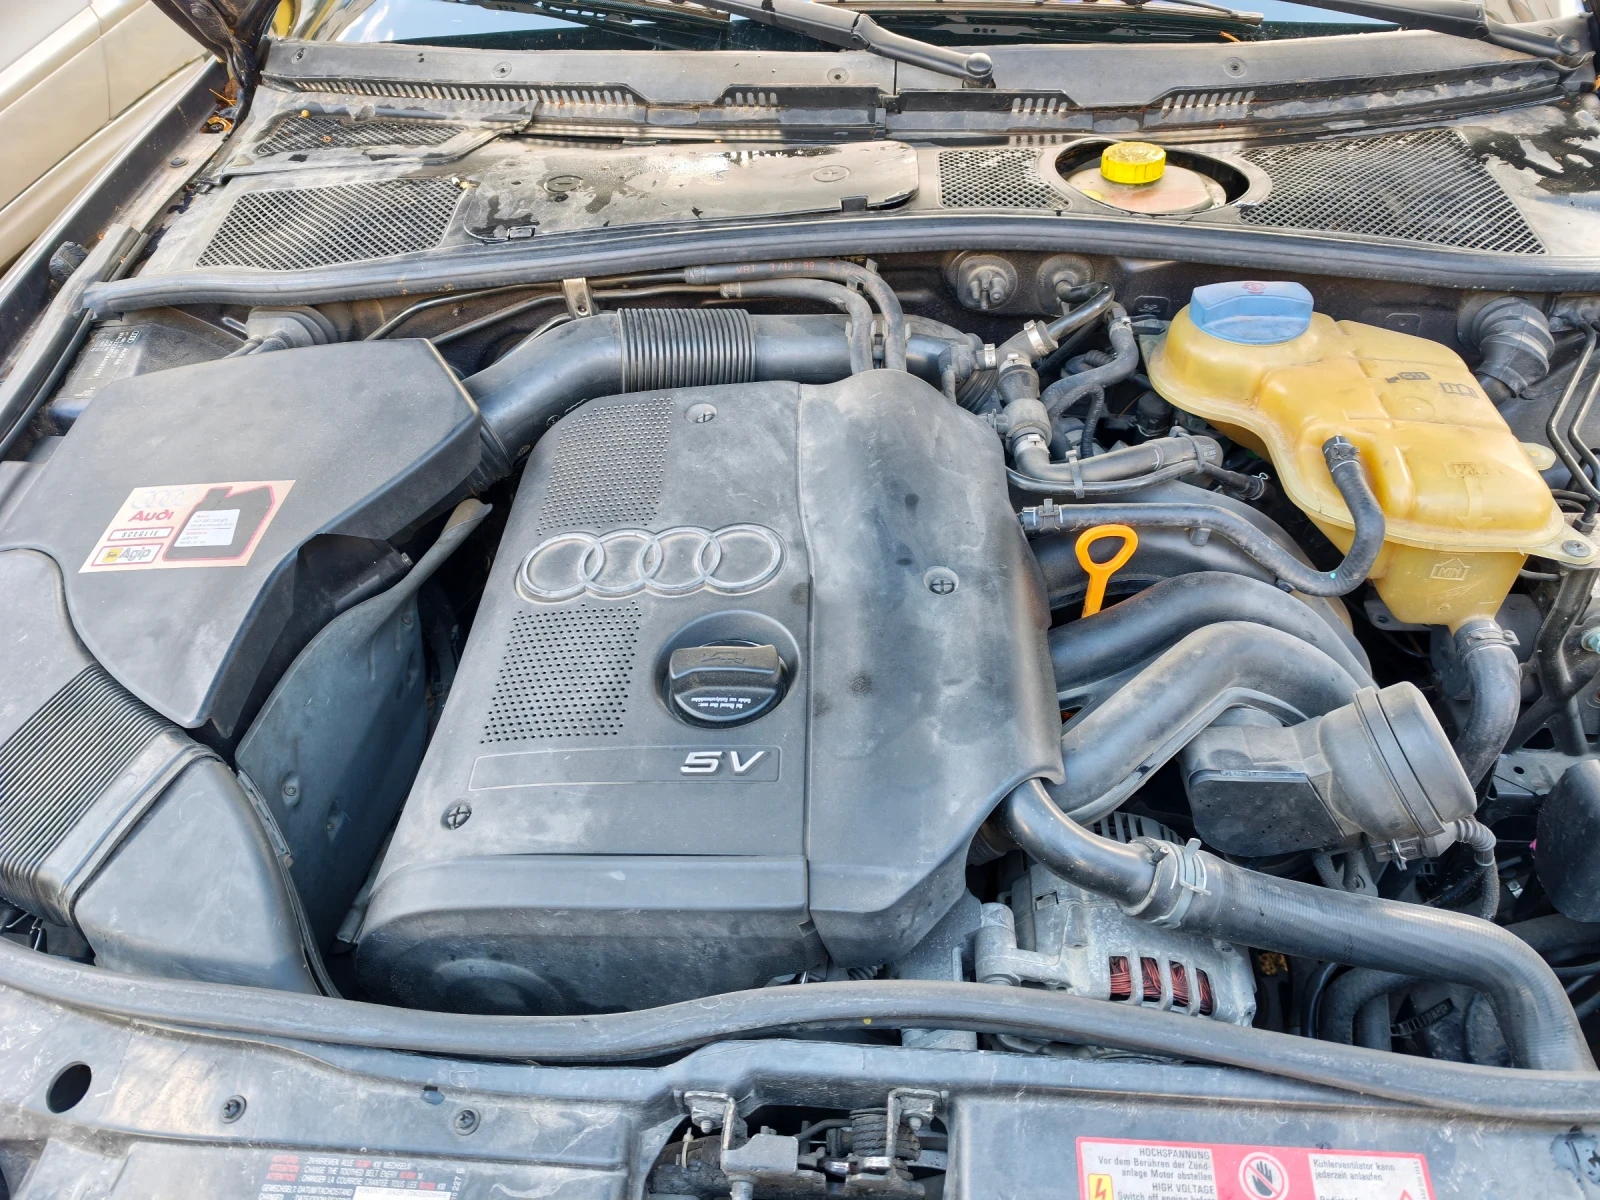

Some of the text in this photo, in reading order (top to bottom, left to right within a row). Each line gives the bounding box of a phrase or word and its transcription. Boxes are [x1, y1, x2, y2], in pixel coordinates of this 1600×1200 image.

[128, 509, 175, 522] Audi
[121, 530, 159, 538] SCEGLIE
[119, 547, 151, 562] Agip
[1438, 567, 1463, 577] MIN
[1139, 1148, 1210, 1160] HOCHSPANNUNG
[1098, 1156, 1112, 1165] Vor
[1114, 1157, 1131, 1166] dem
[1172, 1160, 1185, 1169] der
[1376, 1162, 1396, 1171] kann
[1121, 1168, 1213, 1181] anlage Motor abstellen
[1314, 1169, 1383, 1181] jederzeit anlaufen
[1152, 1183, 1215, 1195] HIGH VOLTAGE
